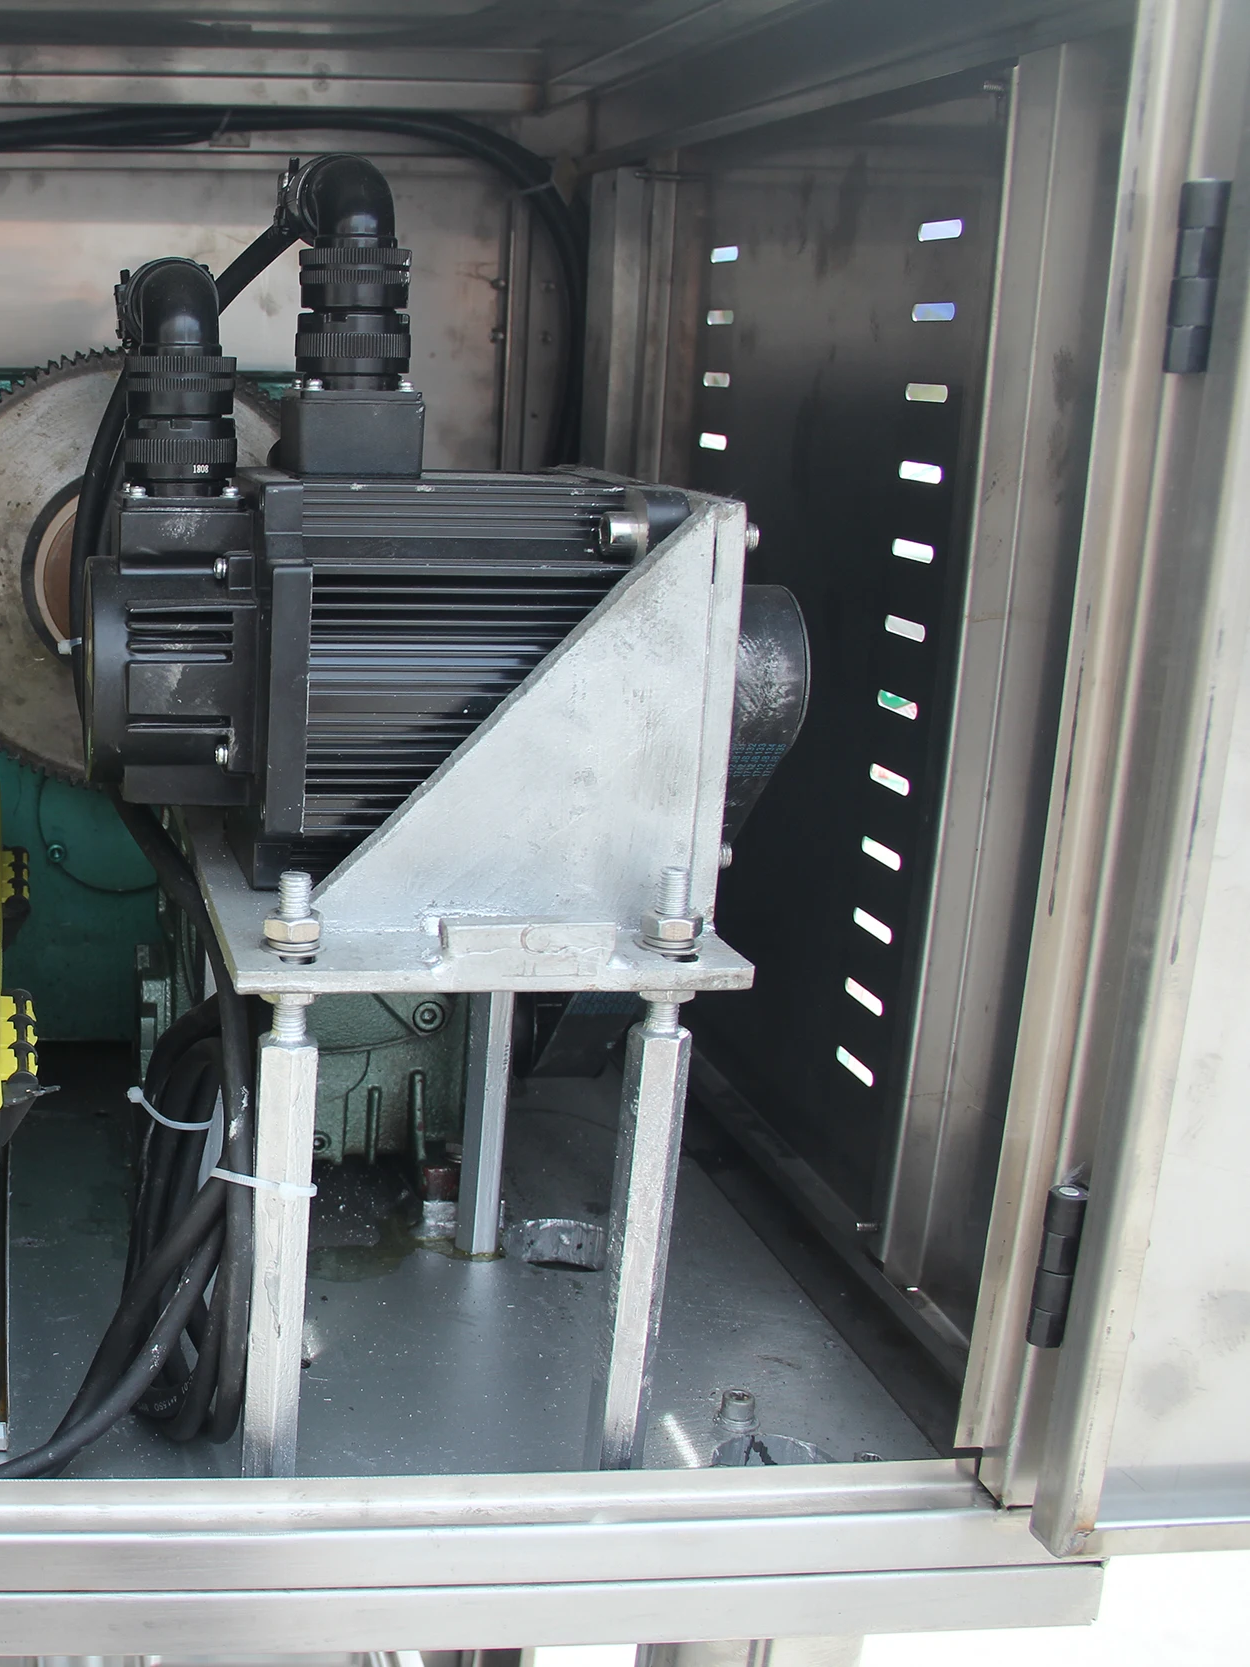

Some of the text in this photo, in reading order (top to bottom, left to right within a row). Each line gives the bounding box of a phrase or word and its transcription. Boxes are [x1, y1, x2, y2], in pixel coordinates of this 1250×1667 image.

[192, 464, 209, 474] 1808
[744, 743, 757, 755] 132
[754, 743, 767, 755] 133
[764, 743, 777, 755] 134
[773, 743, 787, 755] 135
